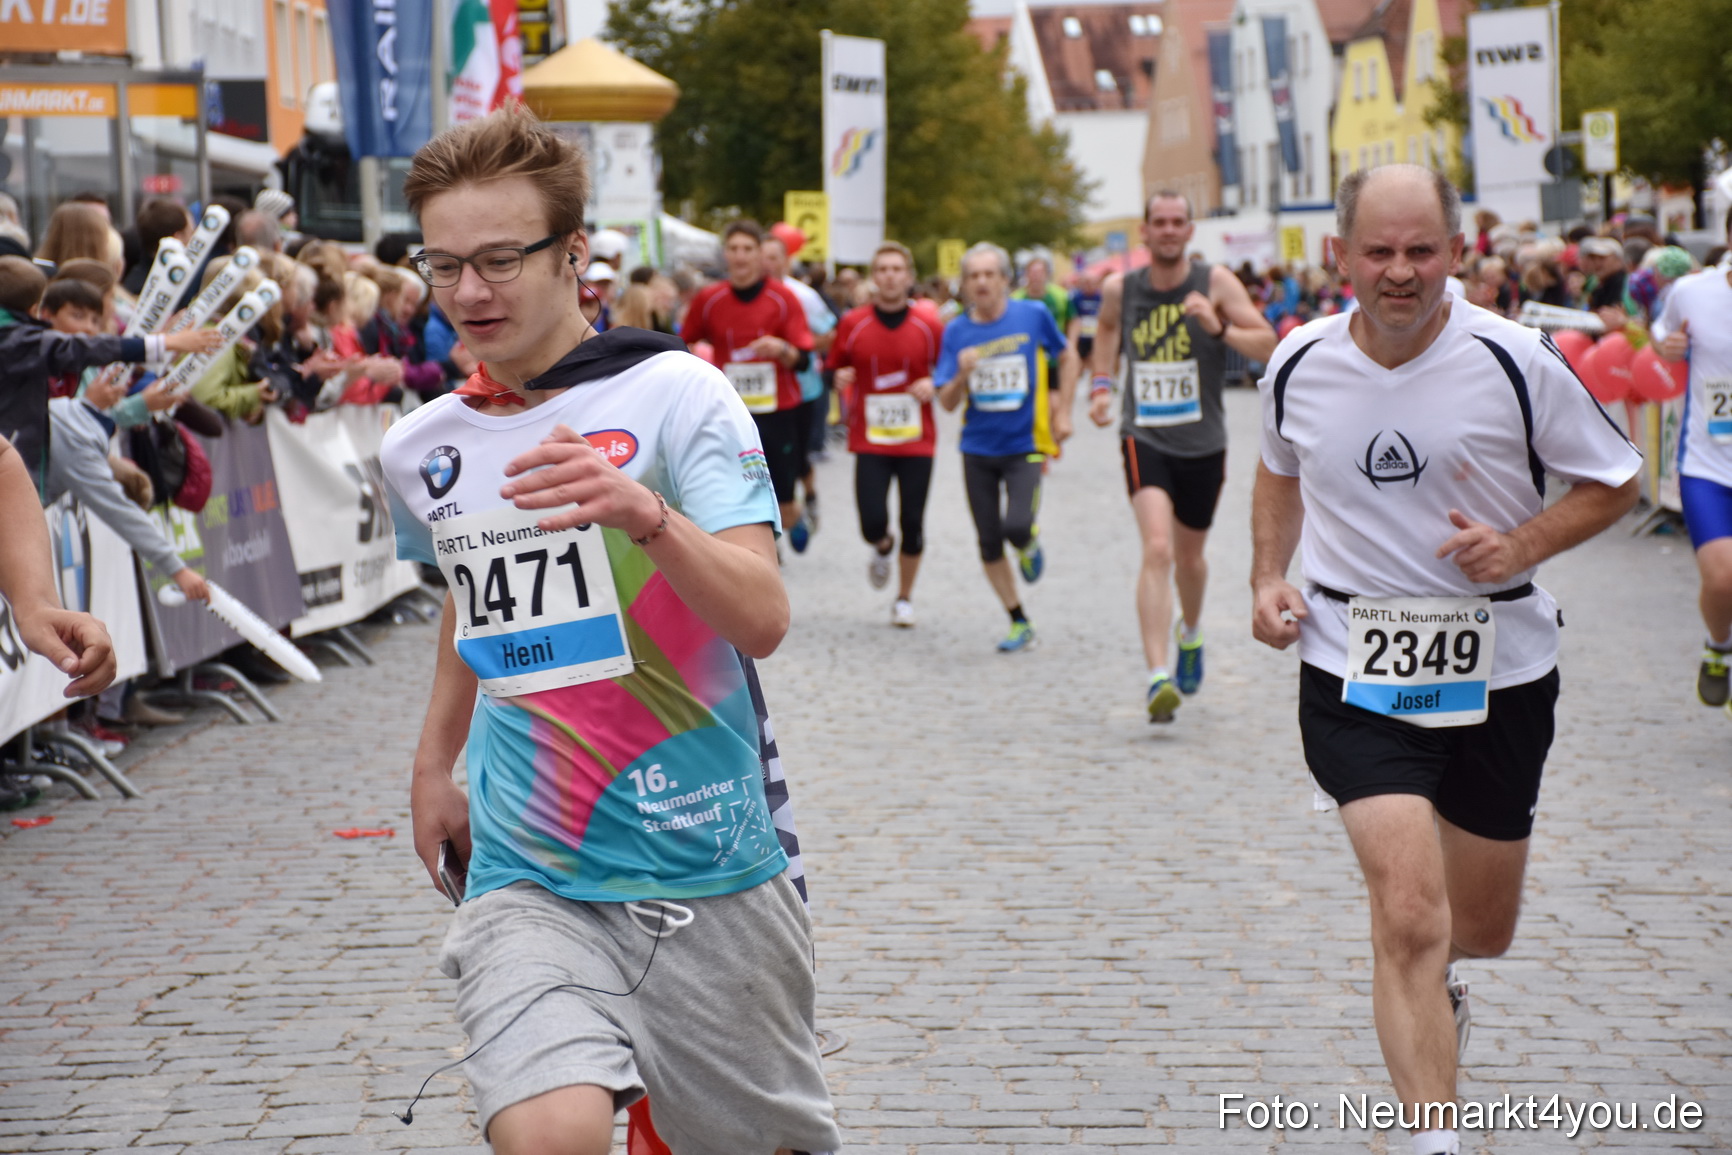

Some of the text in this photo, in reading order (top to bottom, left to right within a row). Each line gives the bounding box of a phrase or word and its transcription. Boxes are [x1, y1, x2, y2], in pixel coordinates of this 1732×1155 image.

[1141, 376, 1193, 401] 2176
[1375, 461, 1409, 471] adidas
[437, 535, 478, 556] PARTL
[454, 542, 590, 627] 2471
[1352, 608, 1470, 623] PARTL Neumarkt
[502, 636, 554, 669] Heni
[1363, 629, 1480, 678] 2349
[1391, 690, 1441, 710] Josef
[627, 763, 679, 797] 16.
[636, 779, 735, 815] Neumarkter
[642, 803, 722, 833] Stadtlauf
[726, 817, 749, 856] September
